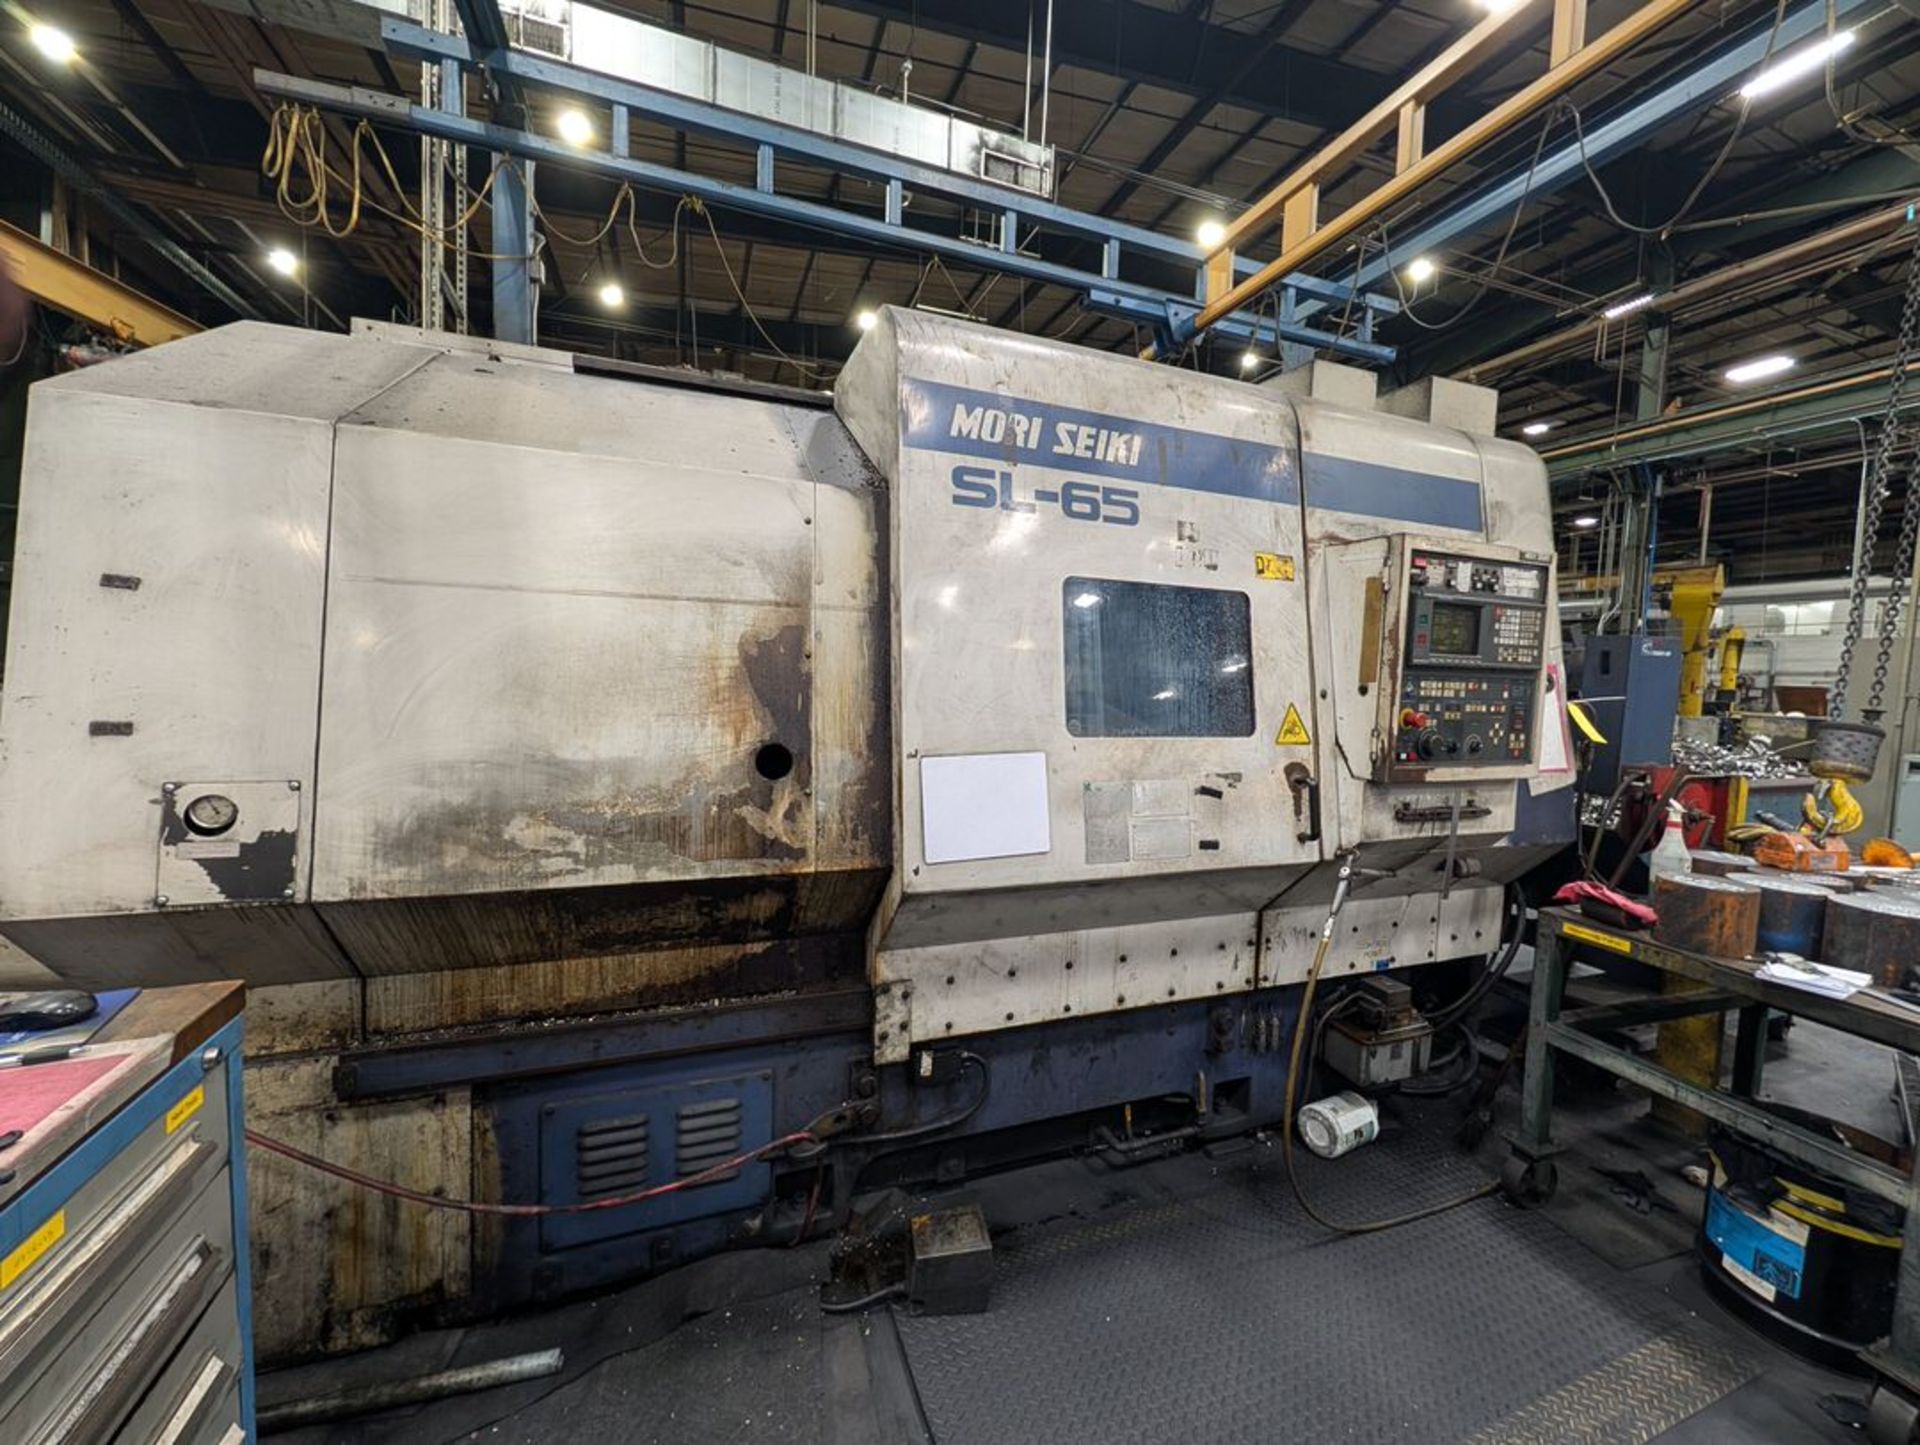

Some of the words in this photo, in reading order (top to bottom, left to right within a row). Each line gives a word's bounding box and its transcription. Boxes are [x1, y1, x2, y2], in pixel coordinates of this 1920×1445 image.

[950, 403, 1043, 450] MORI
[1052, 421, 1142, 467] SEIKI
[951, 465, 1140, 526] SL-65
